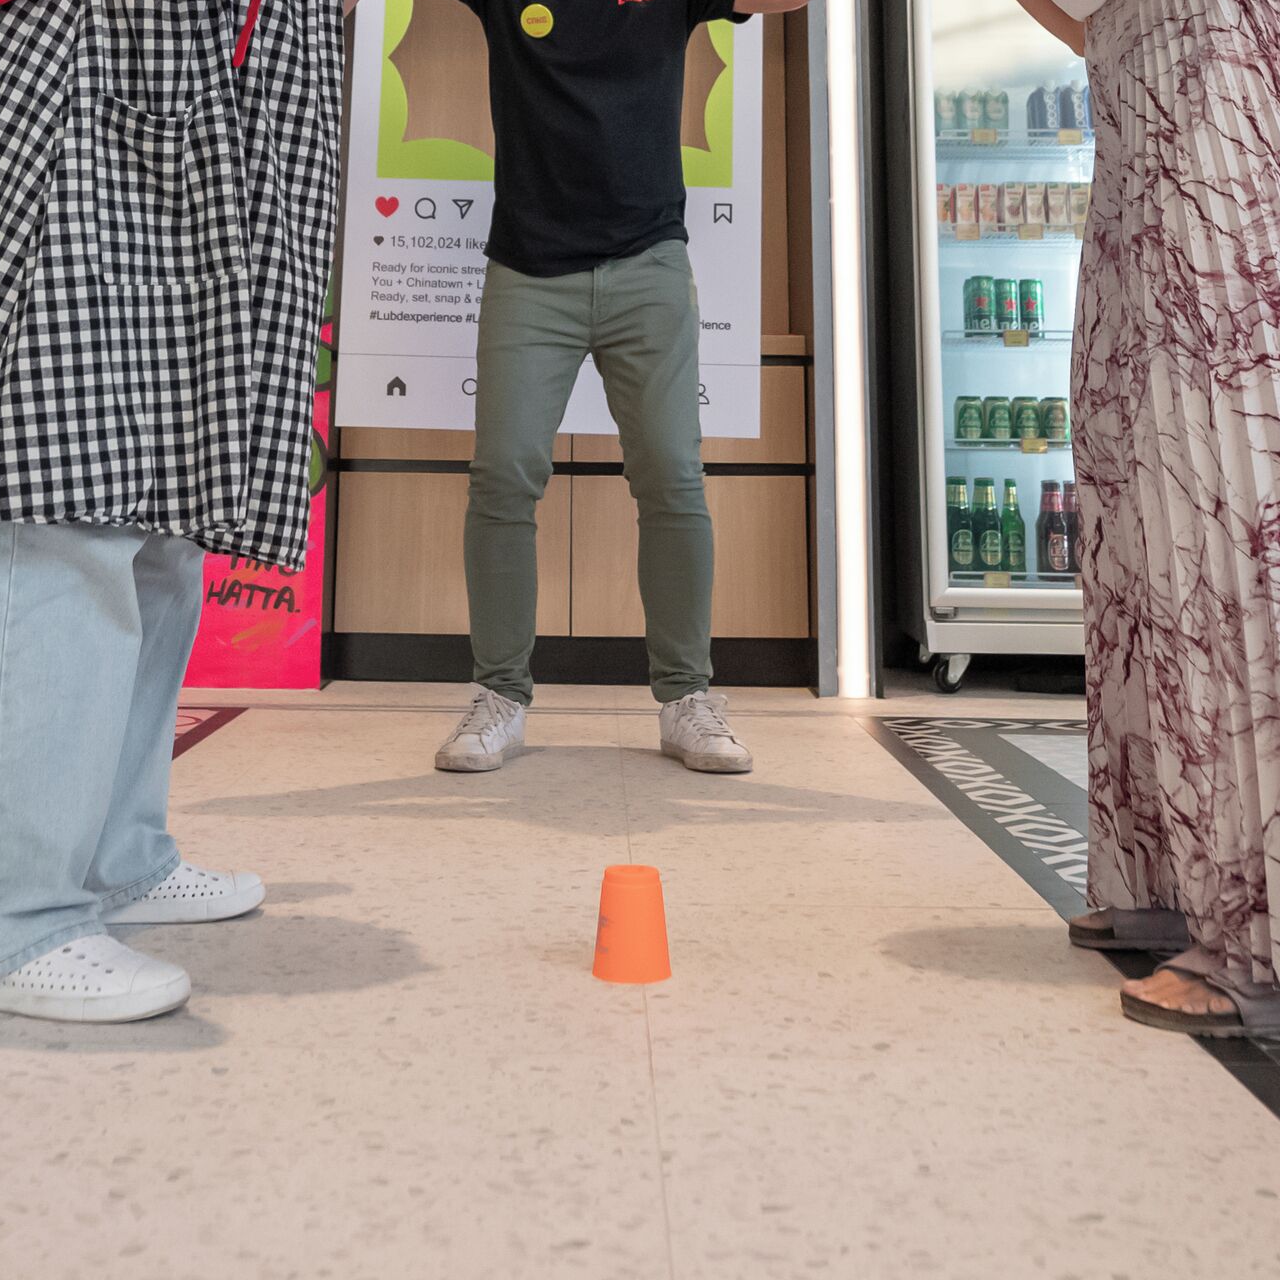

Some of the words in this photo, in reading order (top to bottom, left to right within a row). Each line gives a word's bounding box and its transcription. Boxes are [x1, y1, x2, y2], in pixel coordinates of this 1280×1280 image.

[390, 235, 461, 250] 15,102,024
[465, 238, 488, 250] like
[372, 261, 407, 275] Ready
[410, 263, 424, 273] for
[427, 263, 458, 274] iconic
[371, 276, 393, 287] You
[406, 277, 463, 289] Chinatown
[370, 290, 408, 304] Ready,
[412, 293, 431, 304] set,
[434, 295, 461, 305] snap
[464, 294, 472, 304] &
[369, 310, 463, 324] #Lubdexperience
[699, 319, 731, 331] ience
[206, 578, 301, 613] HATTA.
